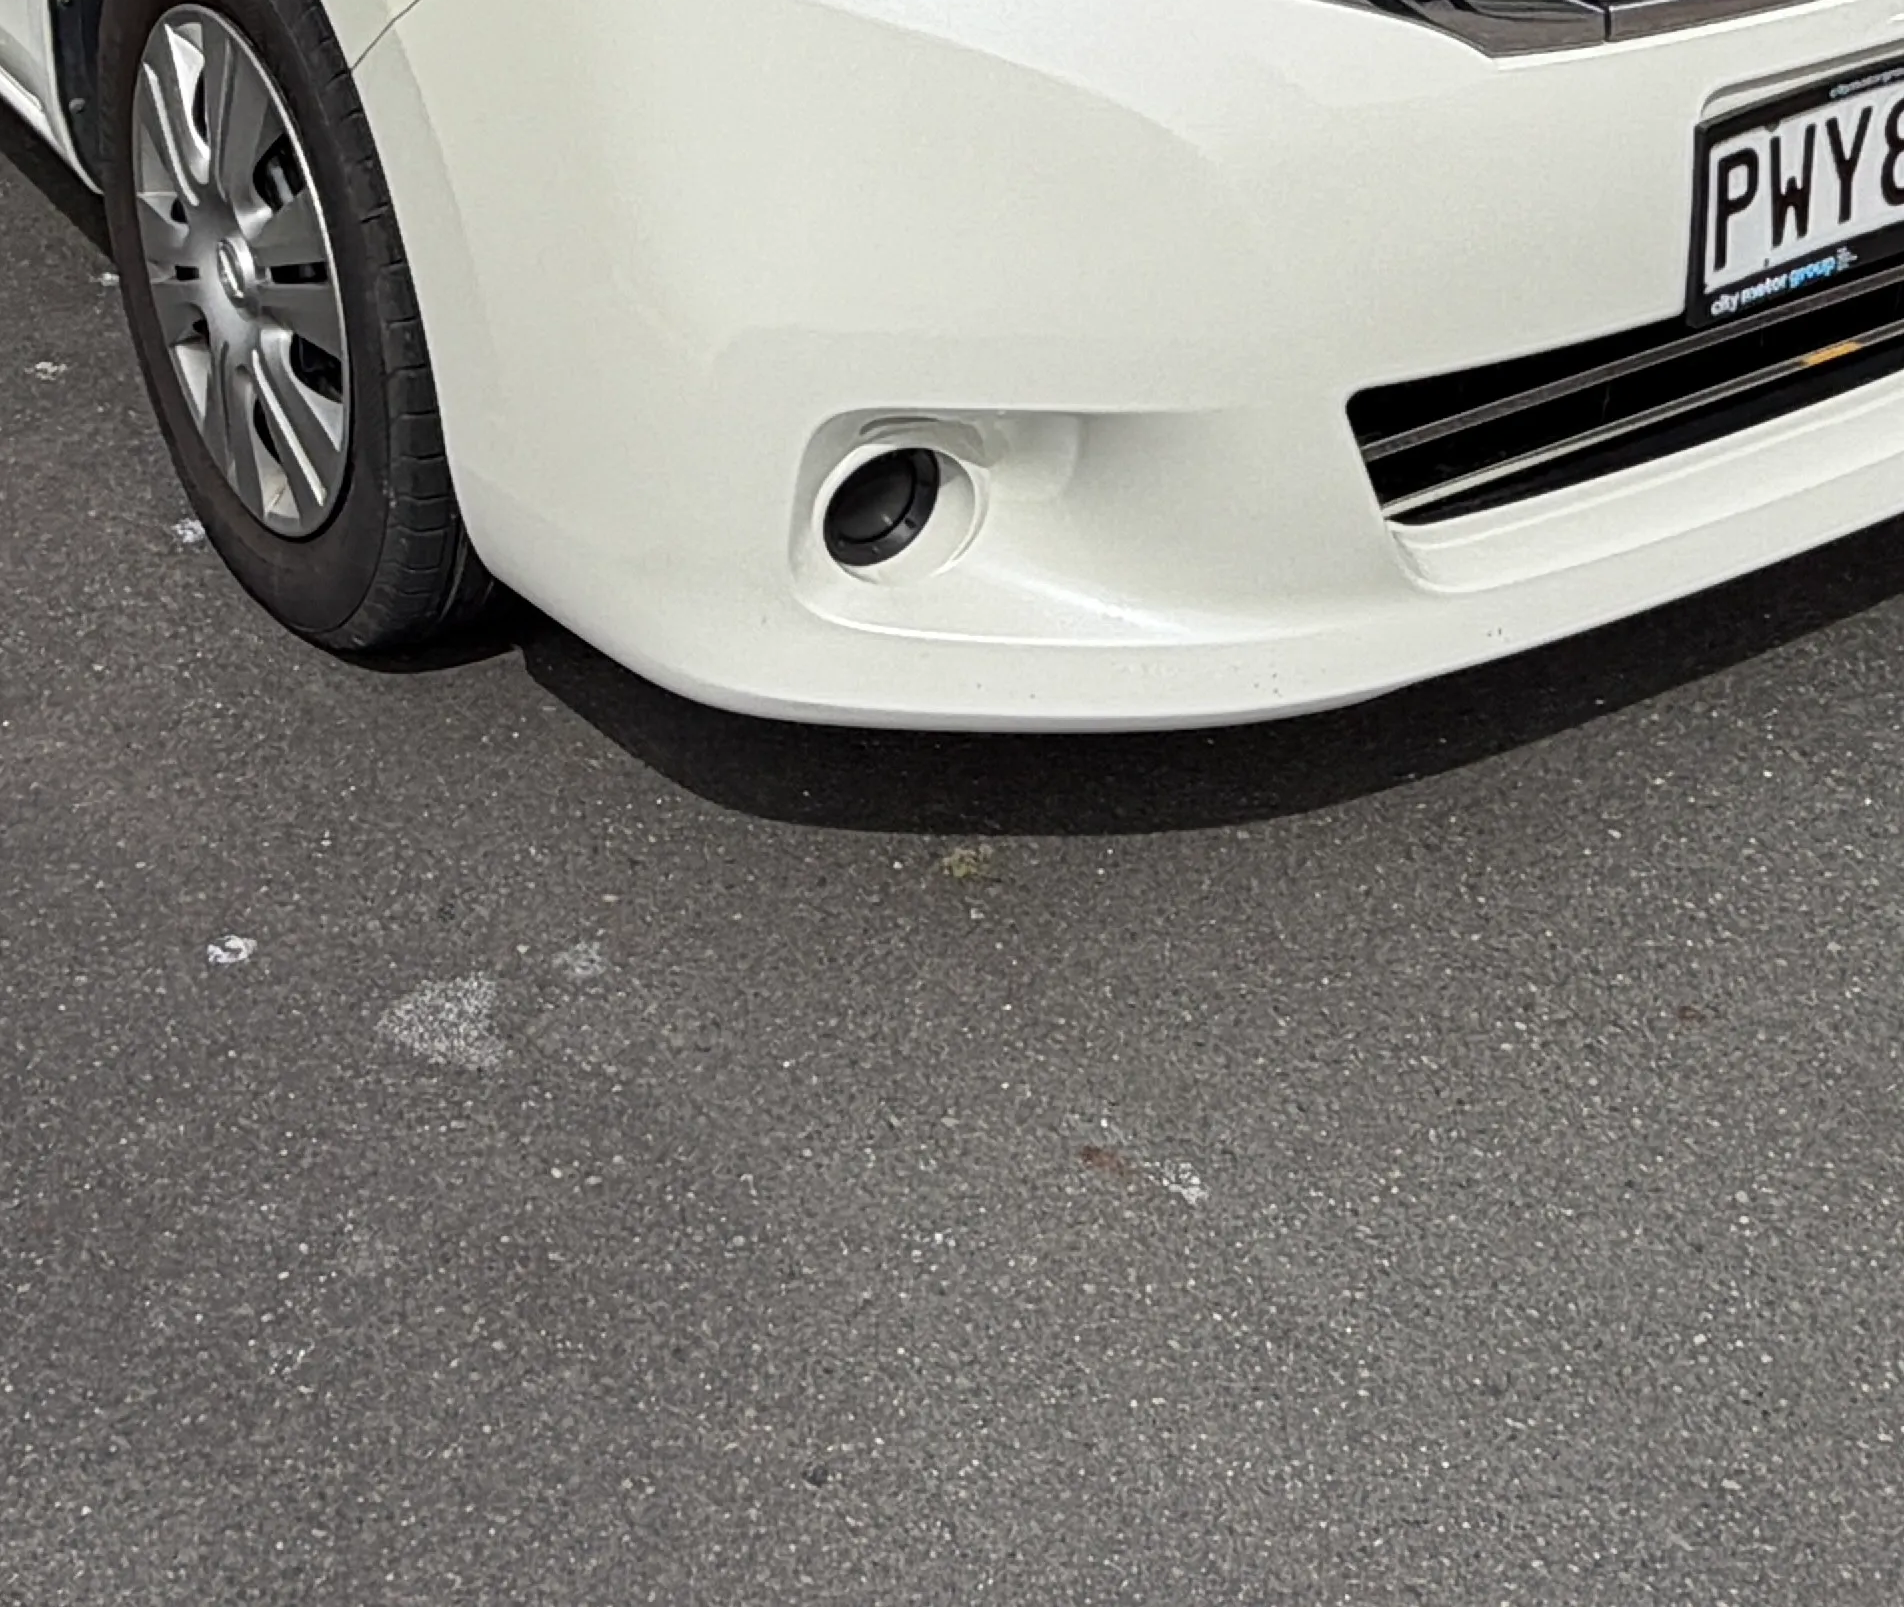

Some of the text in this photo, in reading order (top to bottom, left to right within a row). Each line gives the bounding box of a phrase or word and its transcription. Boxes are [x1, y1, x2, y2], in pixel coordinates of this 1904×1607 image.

[1711, 292, 1740, 317] city
[1741, 273, 1788, 305] motor
[1789, 256, 1836, 289] group
